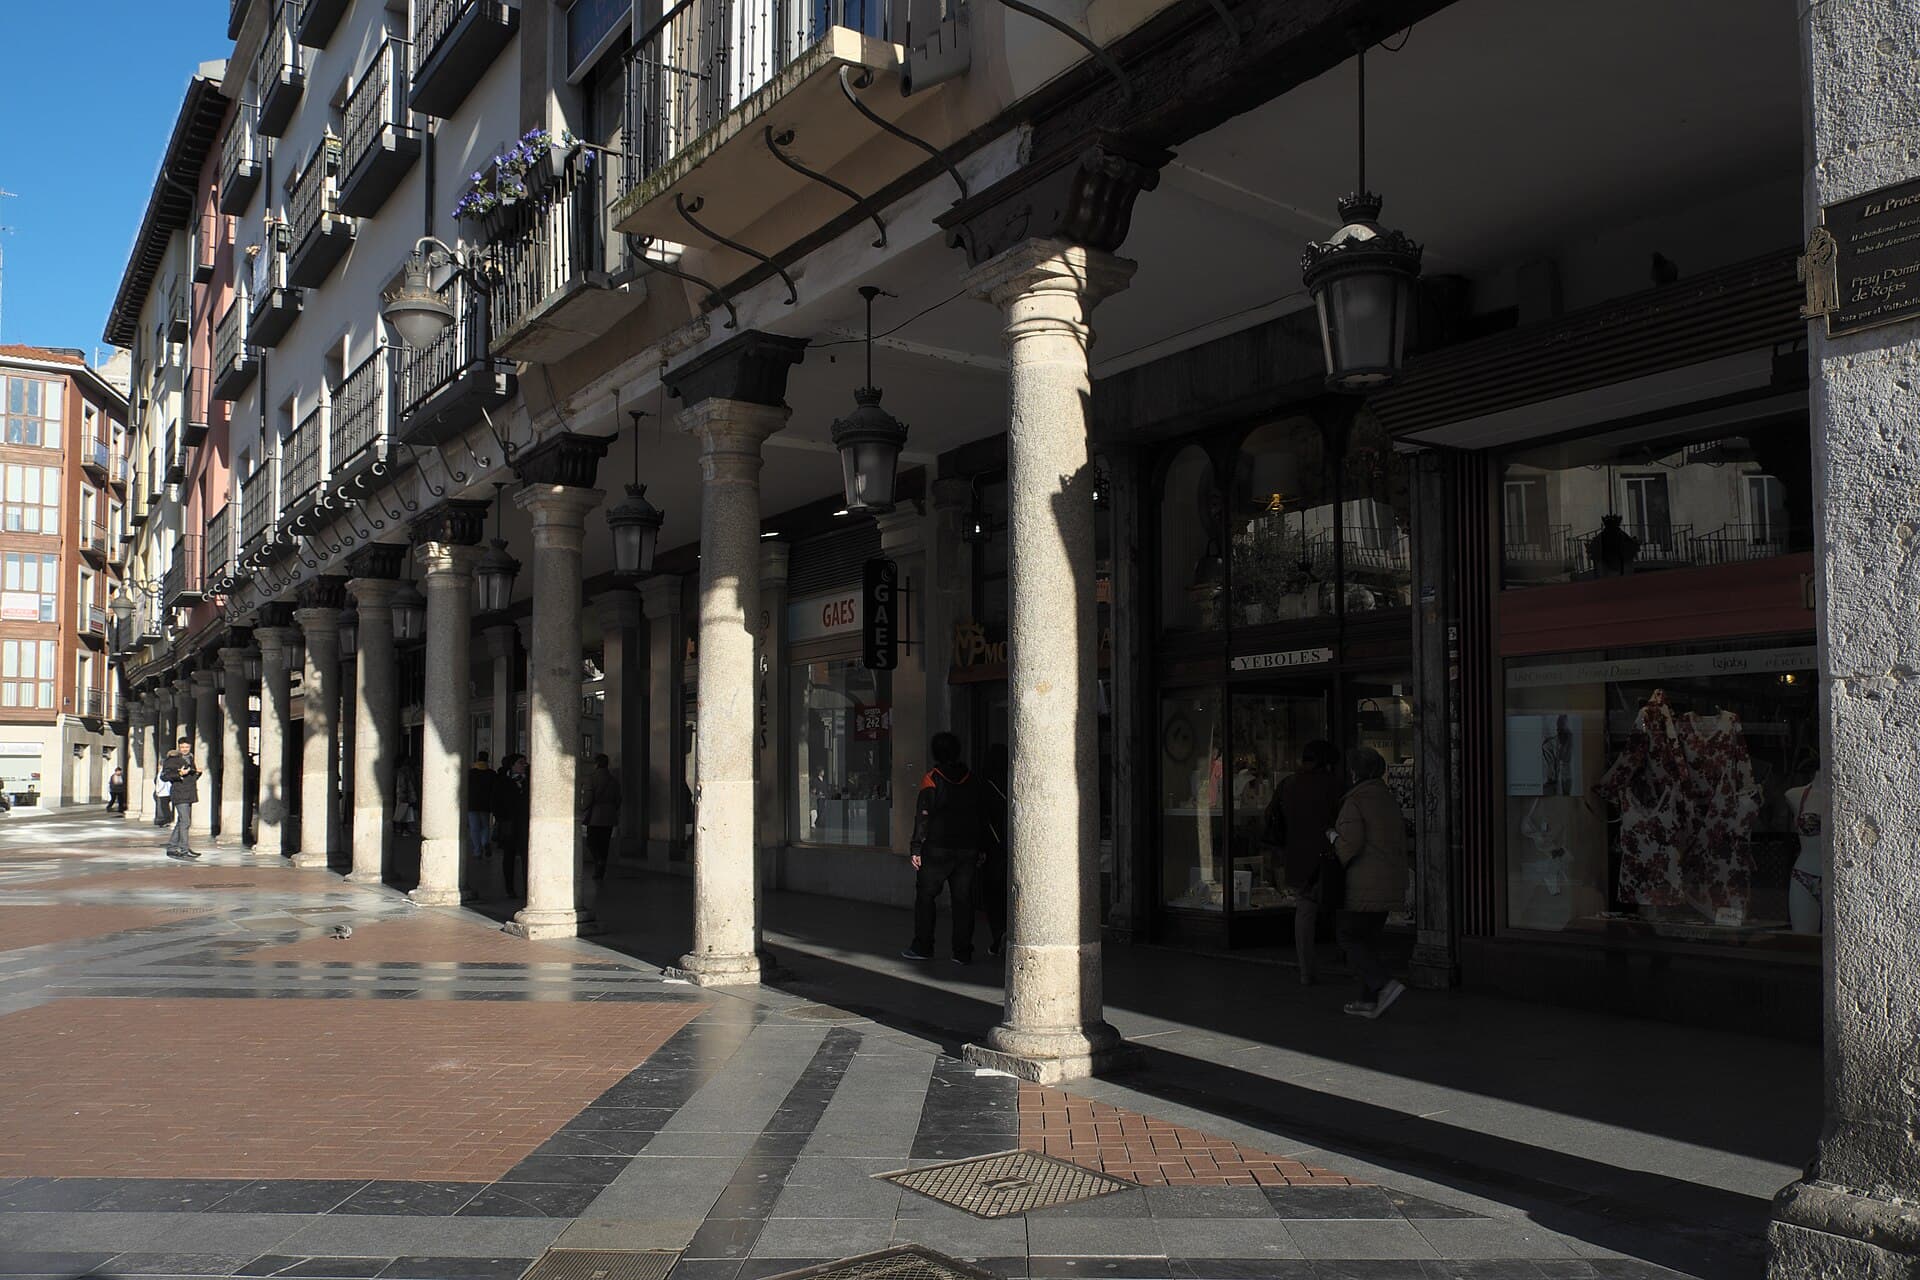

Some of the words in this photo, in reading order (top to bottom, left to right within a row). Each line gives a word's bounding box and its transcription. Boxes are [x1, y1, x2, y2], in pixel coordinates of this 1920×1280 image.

[1864, 204, 1881, 218] La
[1852, 287, 1868, 302] de
[1870, 280, 1907, 302] Rojas
[822, 598, 855, 627] GAES
[874, 584, 889, 668] GAES
[1240, 650, 1320, 669] YEBOLES
[759, 654, 769, 750] GAES
